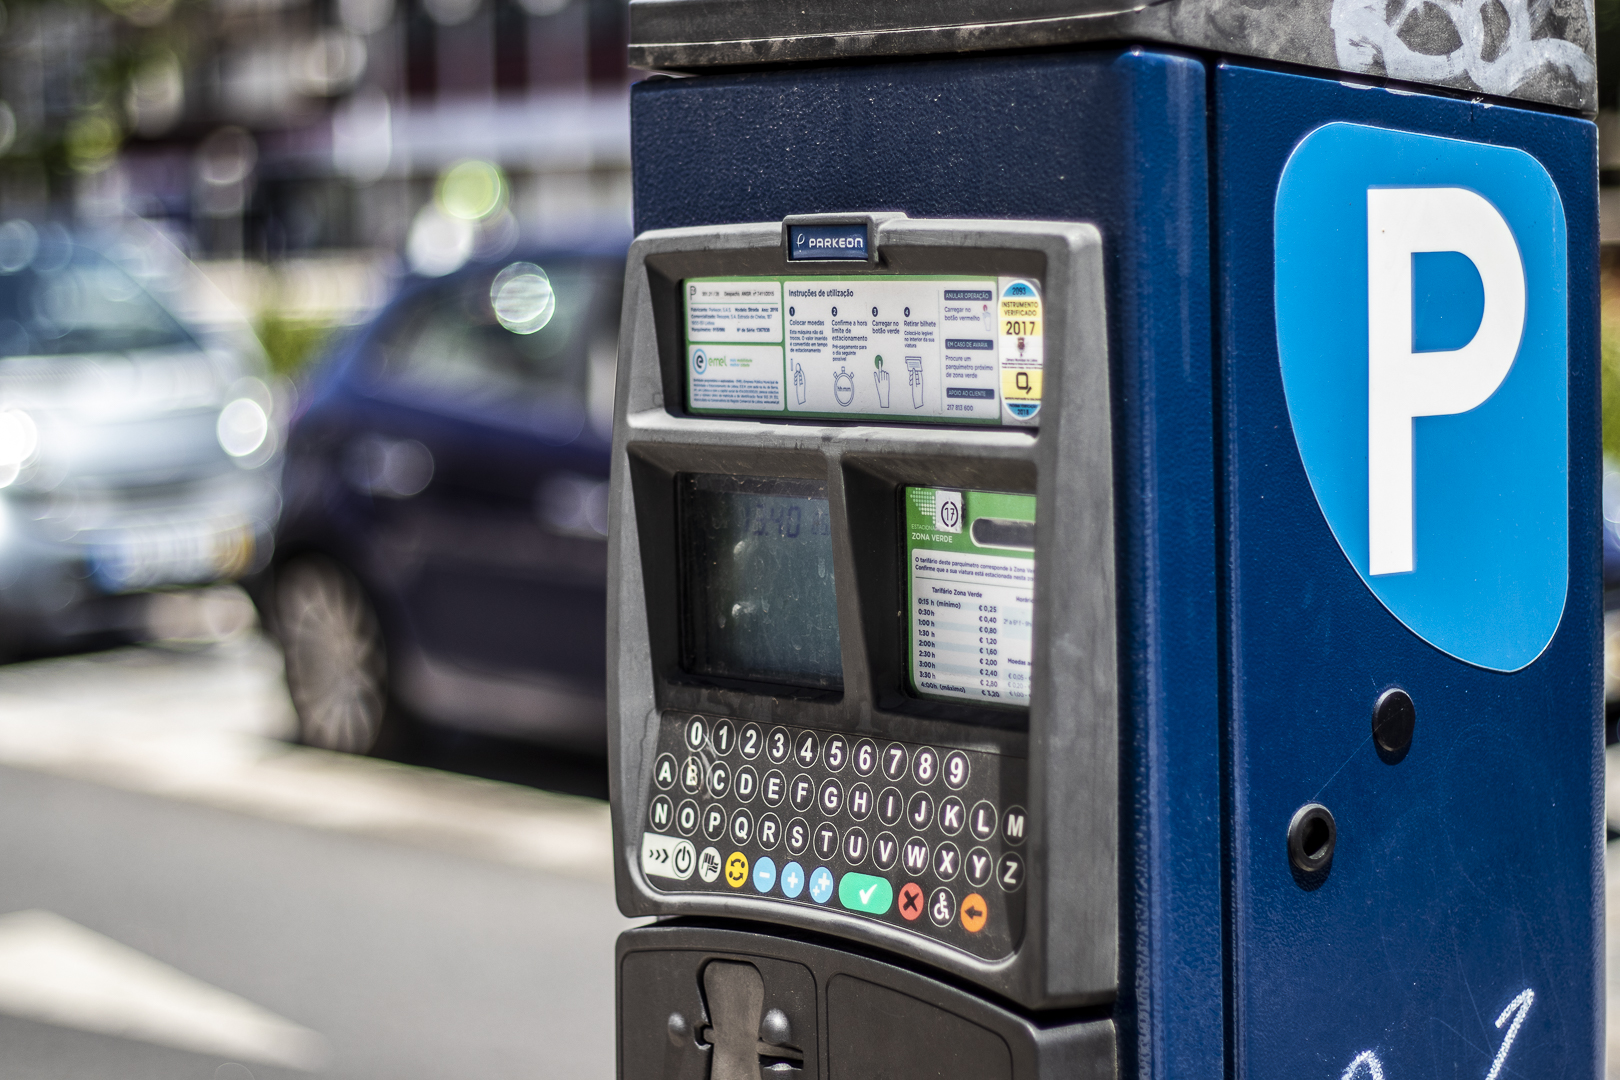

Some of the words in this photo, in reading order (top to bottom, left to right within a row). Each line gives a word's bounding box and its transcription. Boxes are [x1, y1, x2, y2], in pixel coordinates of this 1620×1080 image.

[788, 289, 817, 298] Instruções
[818, 289, 825, 297] de
[826, 289, 854, 298] utilização
[1012, 286, 1026, 295] 2093
[1006, 321, 1035, 335] 2017
[1367, 187, 1526, 576] P
[945, 507, 955, 521] 17
[912, 533, 930, 541] ZONA
[931, 534, 953, 543] VERDE
[952, 560, 979, 569] parquímetro
[985, 571, 1012, 579] estacionada
[932, 586, 952, 595] Tarifário
[954, 588, 966, 596] Zona
[936, 600, 961, 610] (mínimo)
[985, 680, 998, 688] 2,80
[690, 721, 703, 746] 0
[719, 725, 728, 750] 1
[743, 729, 757, 754] 2
[772, 732, 785, 758] 3
[799, 737, 813, 762] 4
[829, 740, 843, 766] 5
[858, 744, 872, 771] 6
[889, 748, 903, 775] 7
[918, 752, 933, 780] 8
[949, 756, 965, 785] 9
[658, 761, 672, 783] A
[686, 765, 698, 786] B
[712, 769, 726, 791] C
[739, 773, 753, 795] D
[767, 777, 781, 800] E
[796, 780, 809, 803] F
[824, 786, 838, 809] G
[853, 790, 868, 813] H
[886, 795, 894, 818] I
[914, 800, 927, 823] J
[944, 804, 960, 828] K
[977, 809, 990, 833] L
[1007, 814, 1024, 837] M
[654, 802, 668, 825] N
[680, 807, 695, 829] O
[708, 811, 721, 833] P
[734, 816, 749, 840] Q
[762, 820, 776, 843] R
[791, 825, 804, 848] S
[821, 830, 833, 852] T
[848, 835, 863, 858] U
[879, 839, 893, 863] V
[907, 844, 927, 869] W
[939, 849, 955, 874] X
[972, 854, 987, 879] Y
[1003, 861, 1018, 884] Z
